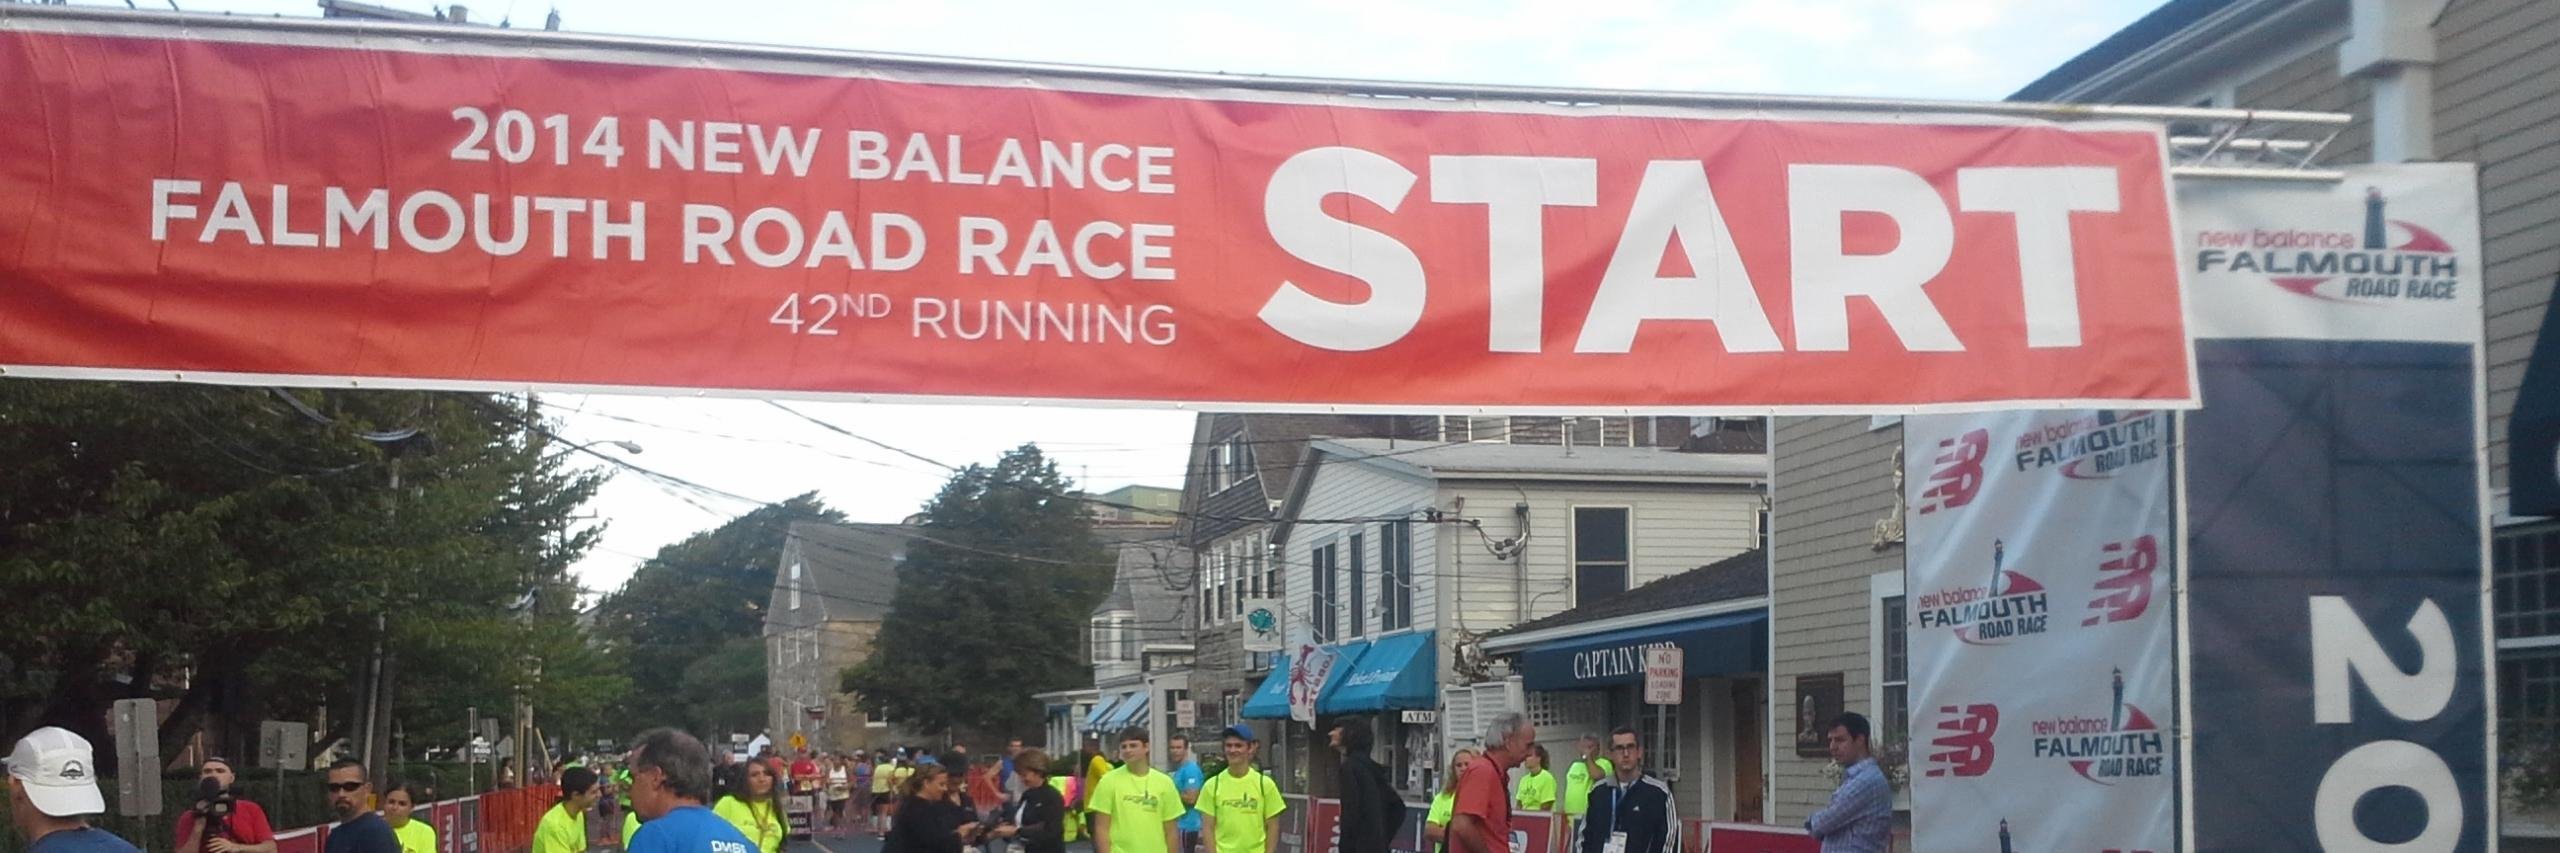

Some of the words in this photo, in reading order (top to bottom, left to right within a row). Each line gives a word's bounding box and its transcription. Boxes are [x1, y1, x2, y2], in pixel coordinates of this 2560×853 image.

[451, 106, 625, 168] 2014
[648, 118, 822, 177] NEW
[848, 129, 1176, 194] BALANCE
[152, 179, 646, 262] FALMOUTH
[683, 203, 926, 271] ROAD
[959, 216, 1176, 281] RACE
[2197, 231, 2247, 249] new
[2253, 228, 2356, 249] balance
[1257, 145, 2121, 353] START
[2197, 250, 2459, 278] FALMOUTH
[2345, 278, 2400, 298] ROAD
[2406, 280, 2458, 300] RACE
[768, 292, 892, 337] 42ND
[913, 298, 1176, 346] RUNNING
[2015, 417, 2156, 472] FALMOUTH
[1918, 593, 2048, 628] FALMOUTH
[1978, 621, 2014, 640] ROAD
[2017, 615, 2048, 636] RACE
[1573, 646, 1635, 680] CAPTAIN
[1658, 653, 1672, 665] NO
[1649, 667, 1679, 678] PARKING
[1406, 712, 1432, 721] ATM
[2032, 719, 2056, 735] new
[2058, 715, 2108, 735] balance
[2034, 733, 2163, 758] FALMOUTH
